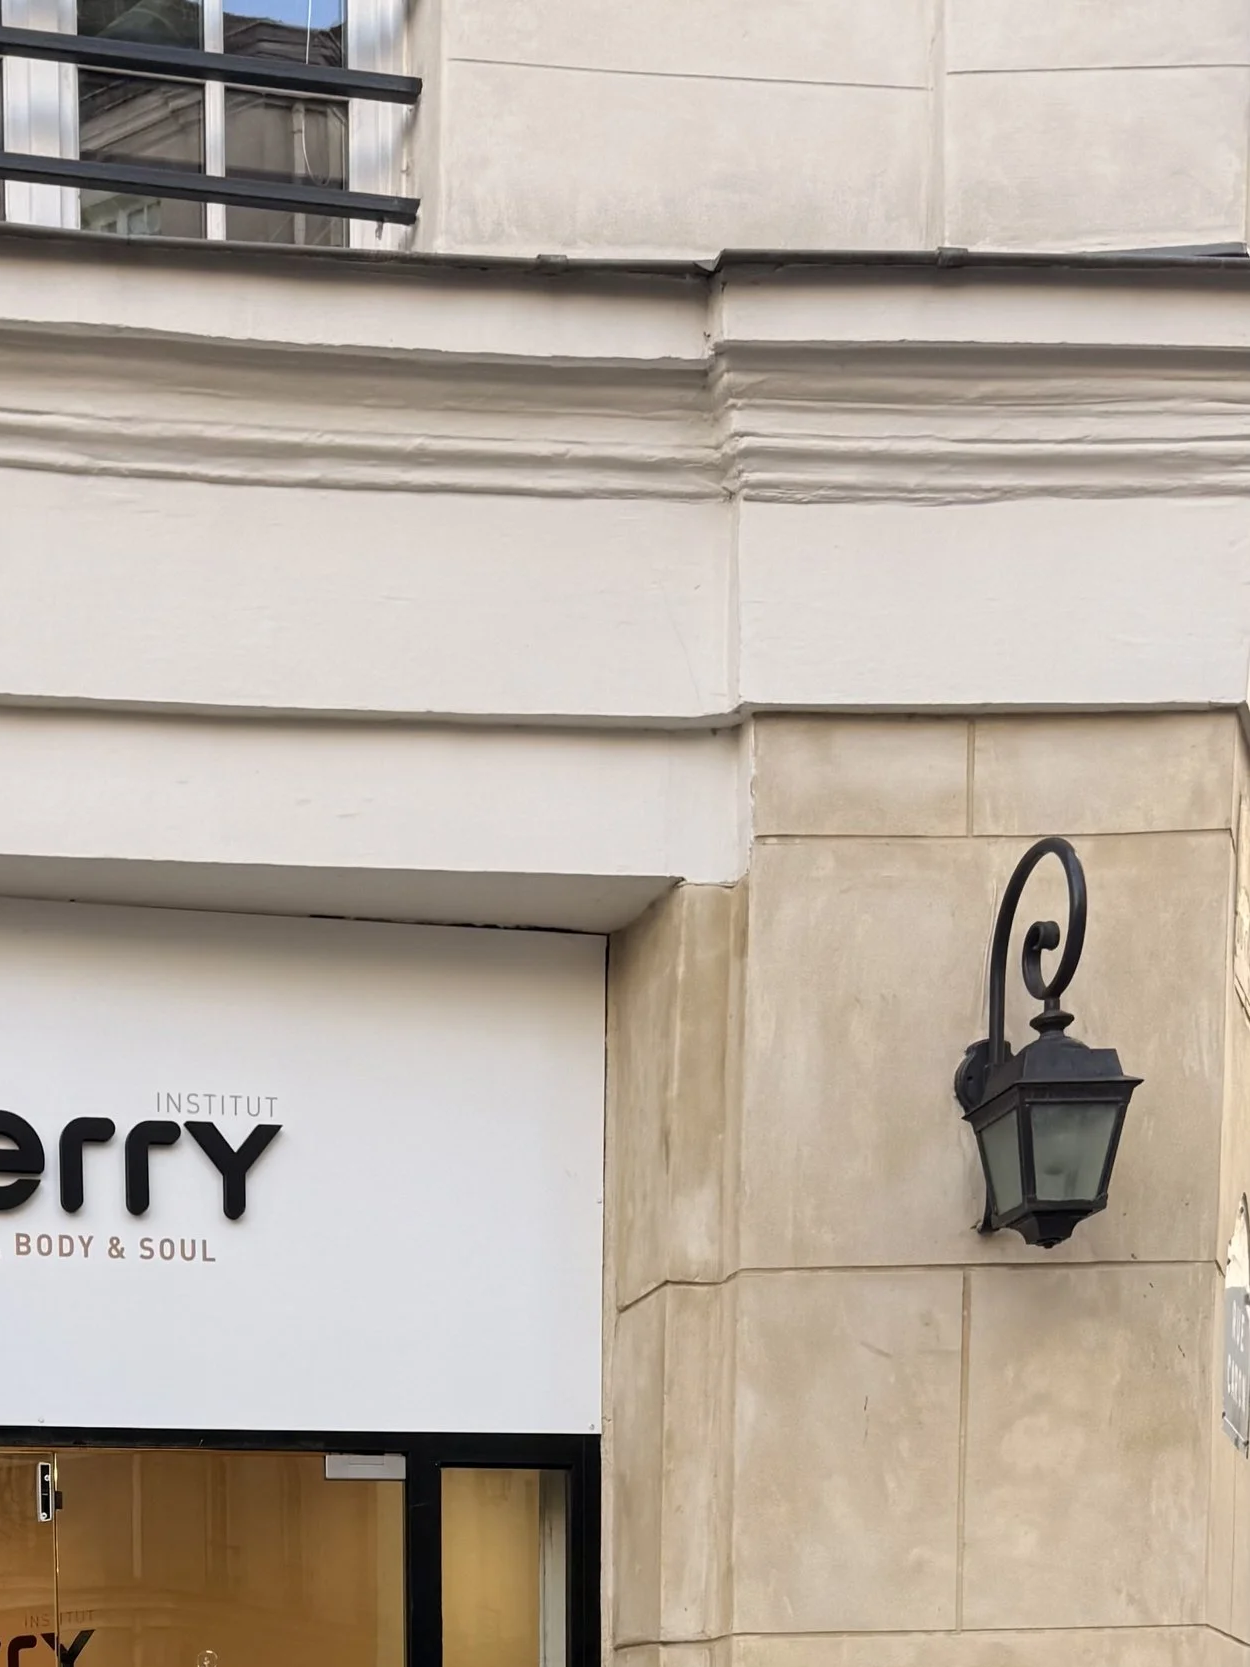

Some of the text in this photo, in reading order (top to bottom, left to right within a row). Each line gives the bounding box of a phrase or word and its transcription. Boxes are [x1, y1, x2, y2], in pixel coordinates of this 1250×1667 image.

[156, 1092, 279, 1118] INSTITUT
[15, 1233, 94, 1258] BODY
[107, 1236, 126, 1259] &
[139, 1238, 216, 1262] SOUL
[25, 1609, 95, 1629] INSITUT
